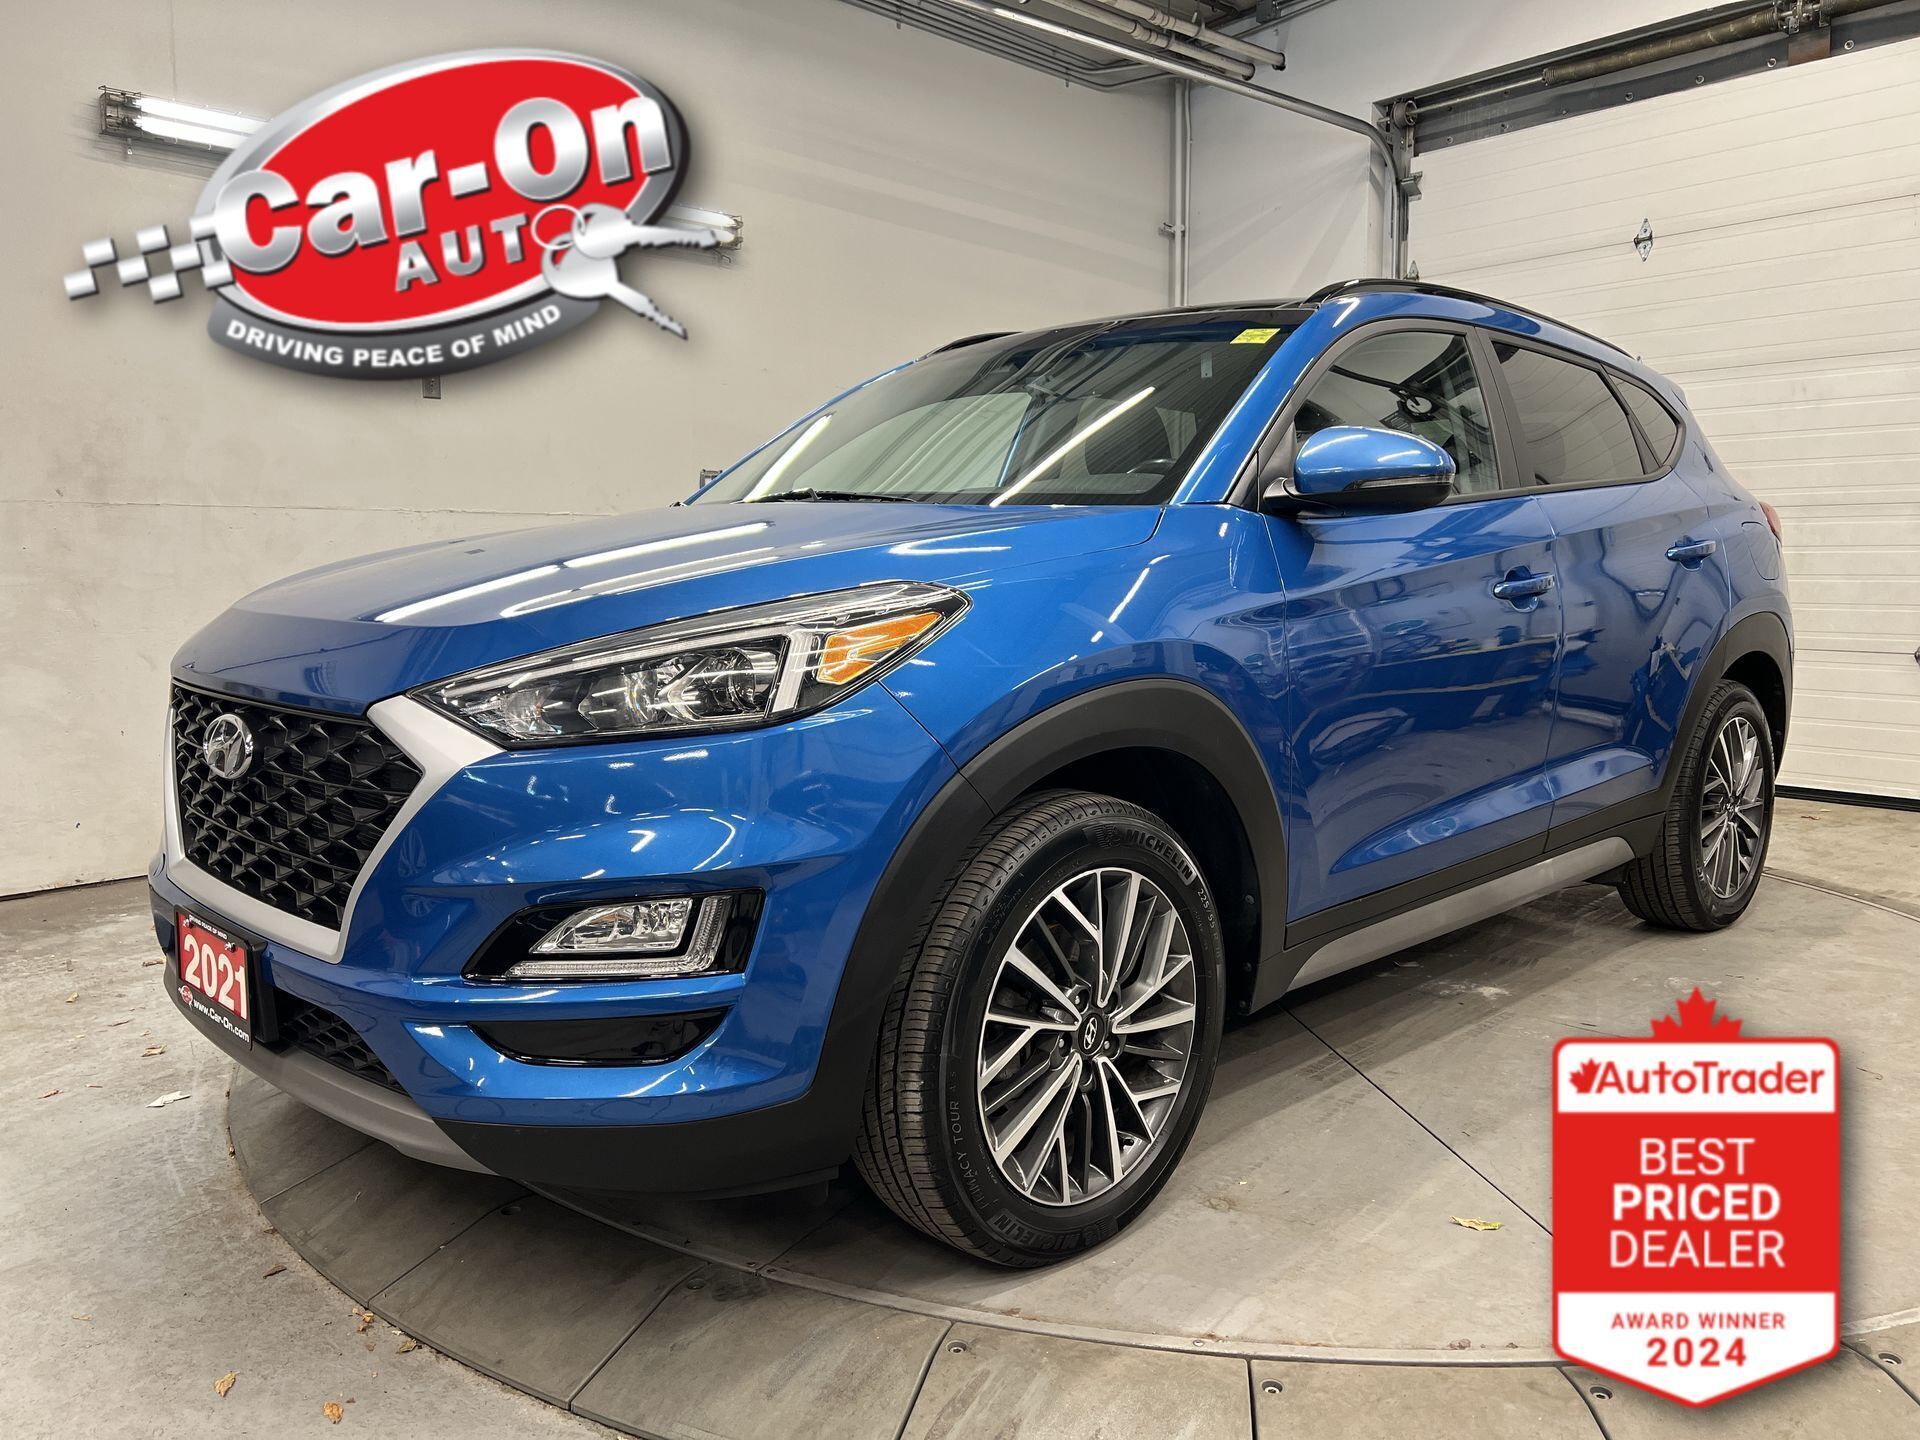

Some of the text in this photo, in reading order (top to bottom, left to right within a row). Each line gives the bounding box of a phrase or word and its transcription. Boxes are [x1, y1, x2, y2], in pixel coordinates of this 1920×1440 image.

[1126, 829, 1193, 880] MICHELIN
[184, 934, 247, 1020] 2021
[193, 999, 250, 1043] www.Car-On.com
[950, 1100, 964, 1145] TOUR
